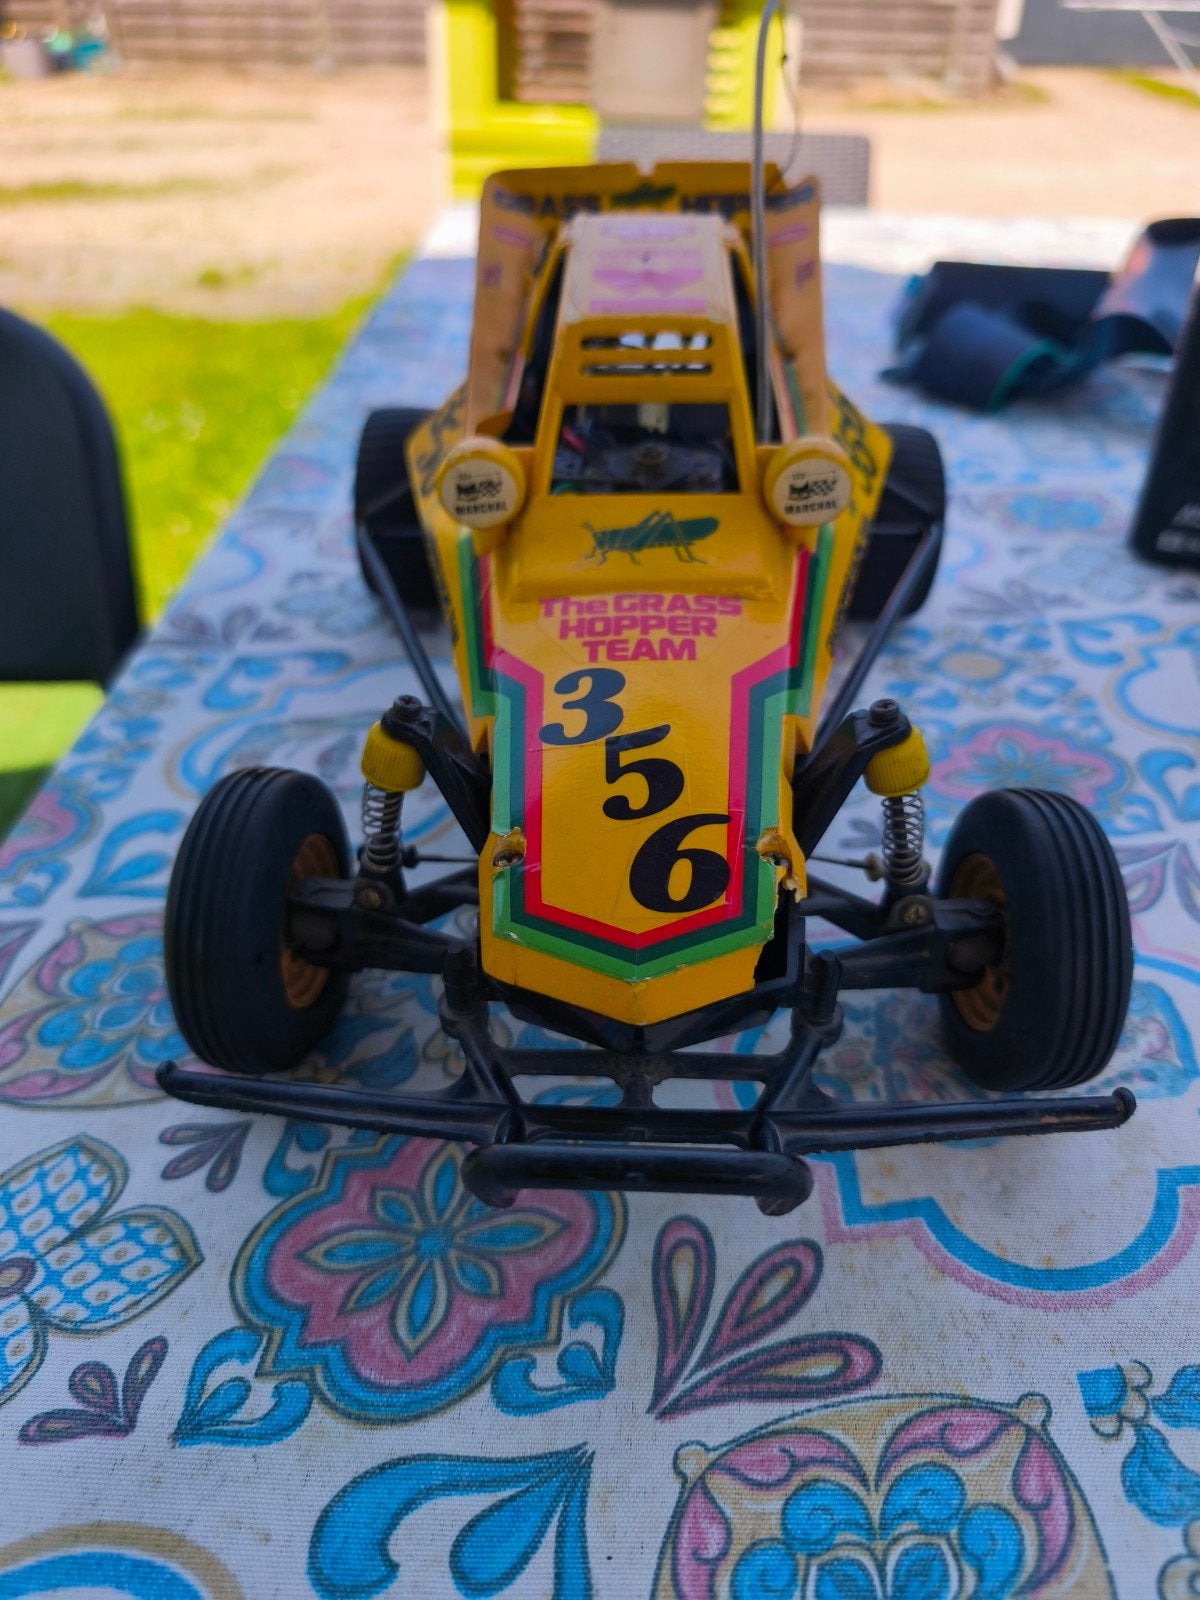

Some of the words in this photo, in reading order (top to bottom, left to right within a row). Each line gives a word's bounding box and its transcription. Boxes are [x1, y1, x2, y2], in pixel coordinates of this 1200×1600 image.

[784, 500, 838, 514] MARCHAL
[540, 597, 608, 618] The
[613, 593, 742, 616] GRASS
[559, 615, 717, 640] HOPPER
[582, 638, 697, 663] TEAM
[538, 667, 627, 746] 3
[602, 723, 685, 820] 5
[629, 813, 732, 913] 6
